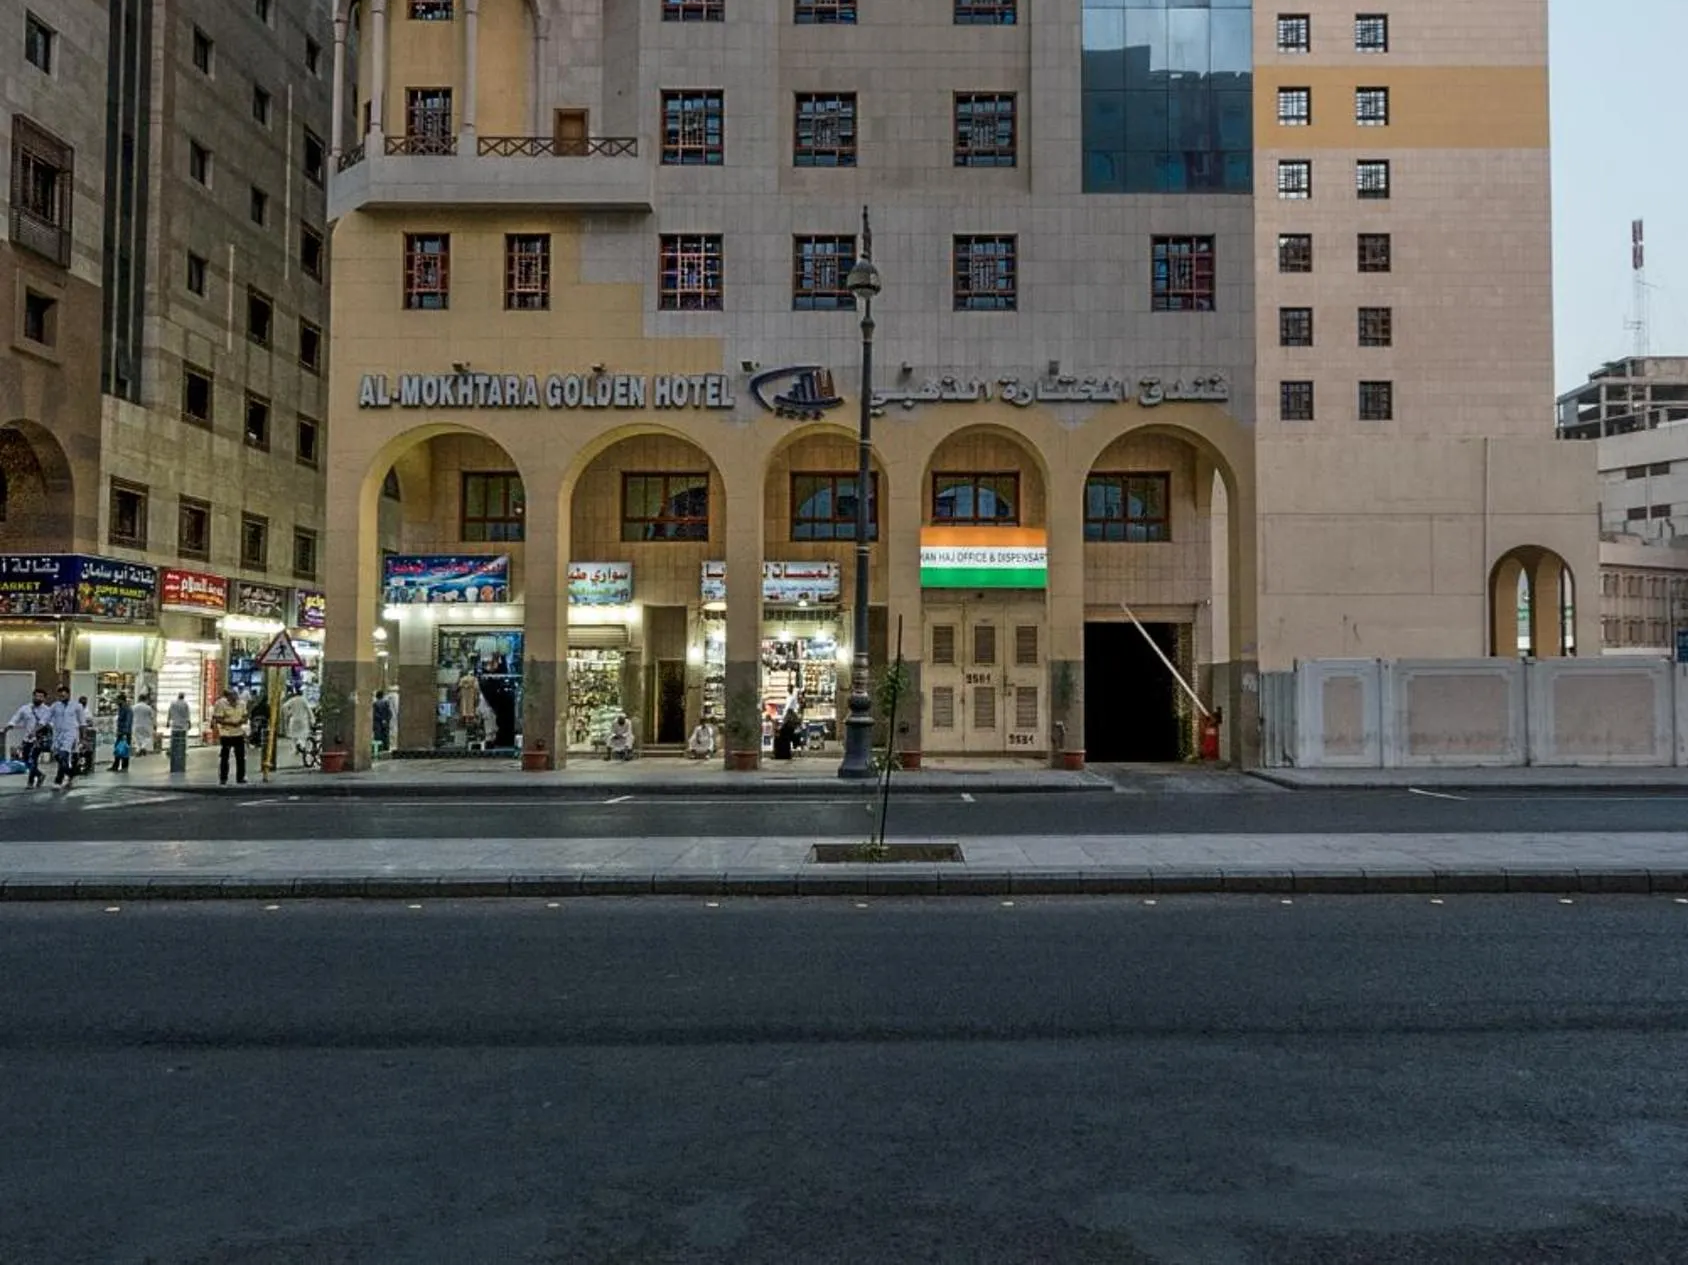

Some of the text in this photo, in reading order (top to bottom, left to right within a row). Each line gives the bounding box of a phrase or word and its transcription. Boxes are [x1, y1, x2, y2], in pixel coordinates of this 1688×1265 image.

[360, 373, 735, 408] AL-MOKHTARA GOLDEN HOTEL
[870, 375, 1228, 417] فندق المختارة الذهبي
[11, 556, 60, 579] بقالة
[939, 551, 955, 563] HAJ
[956, 551, 988, 563] OFFICE
[989, 551, 996, 563] &
[0, 581, 41, 591] ARKET
